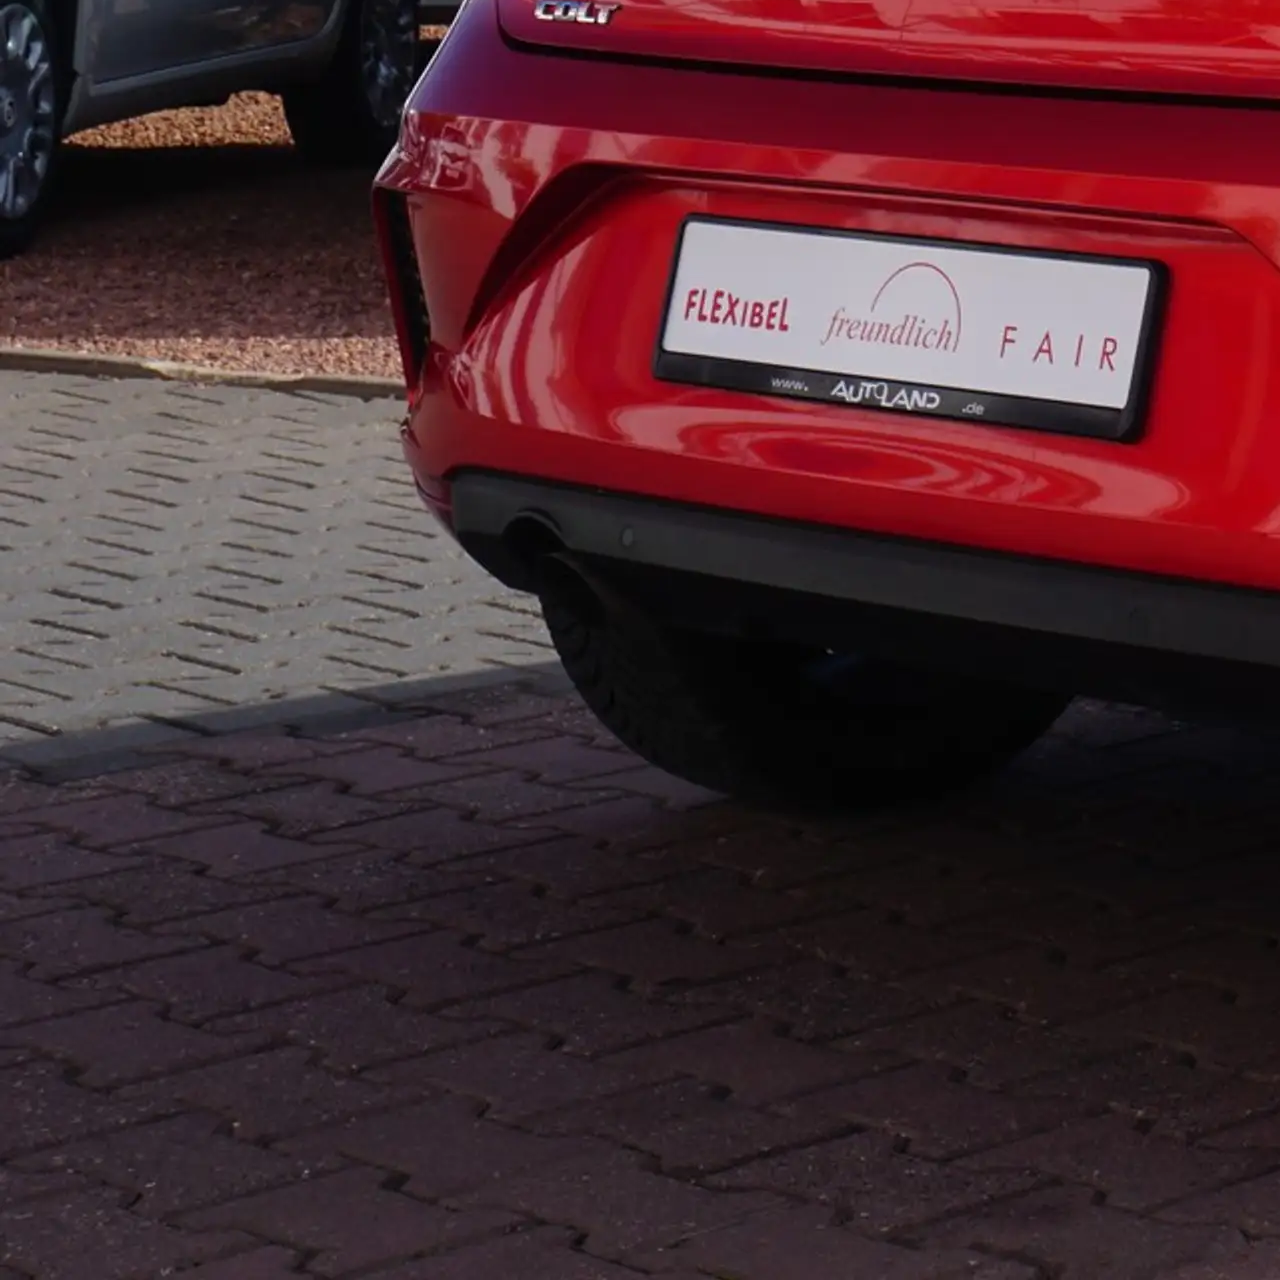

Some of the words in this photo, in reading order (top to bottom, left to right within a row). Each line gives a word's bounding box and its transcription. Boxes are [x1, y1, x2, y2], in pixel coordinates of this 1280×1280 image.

[534, 0, 621, 24] COLT
[684, 288, 790, 332] FLEXIBEL
[820, 306, 956, 353] freundlich
[1000, 325, 1119, 372] FAIR
[830, 379, 940, 410] AUTOLAND
[961, 401, 985, 415] .de
